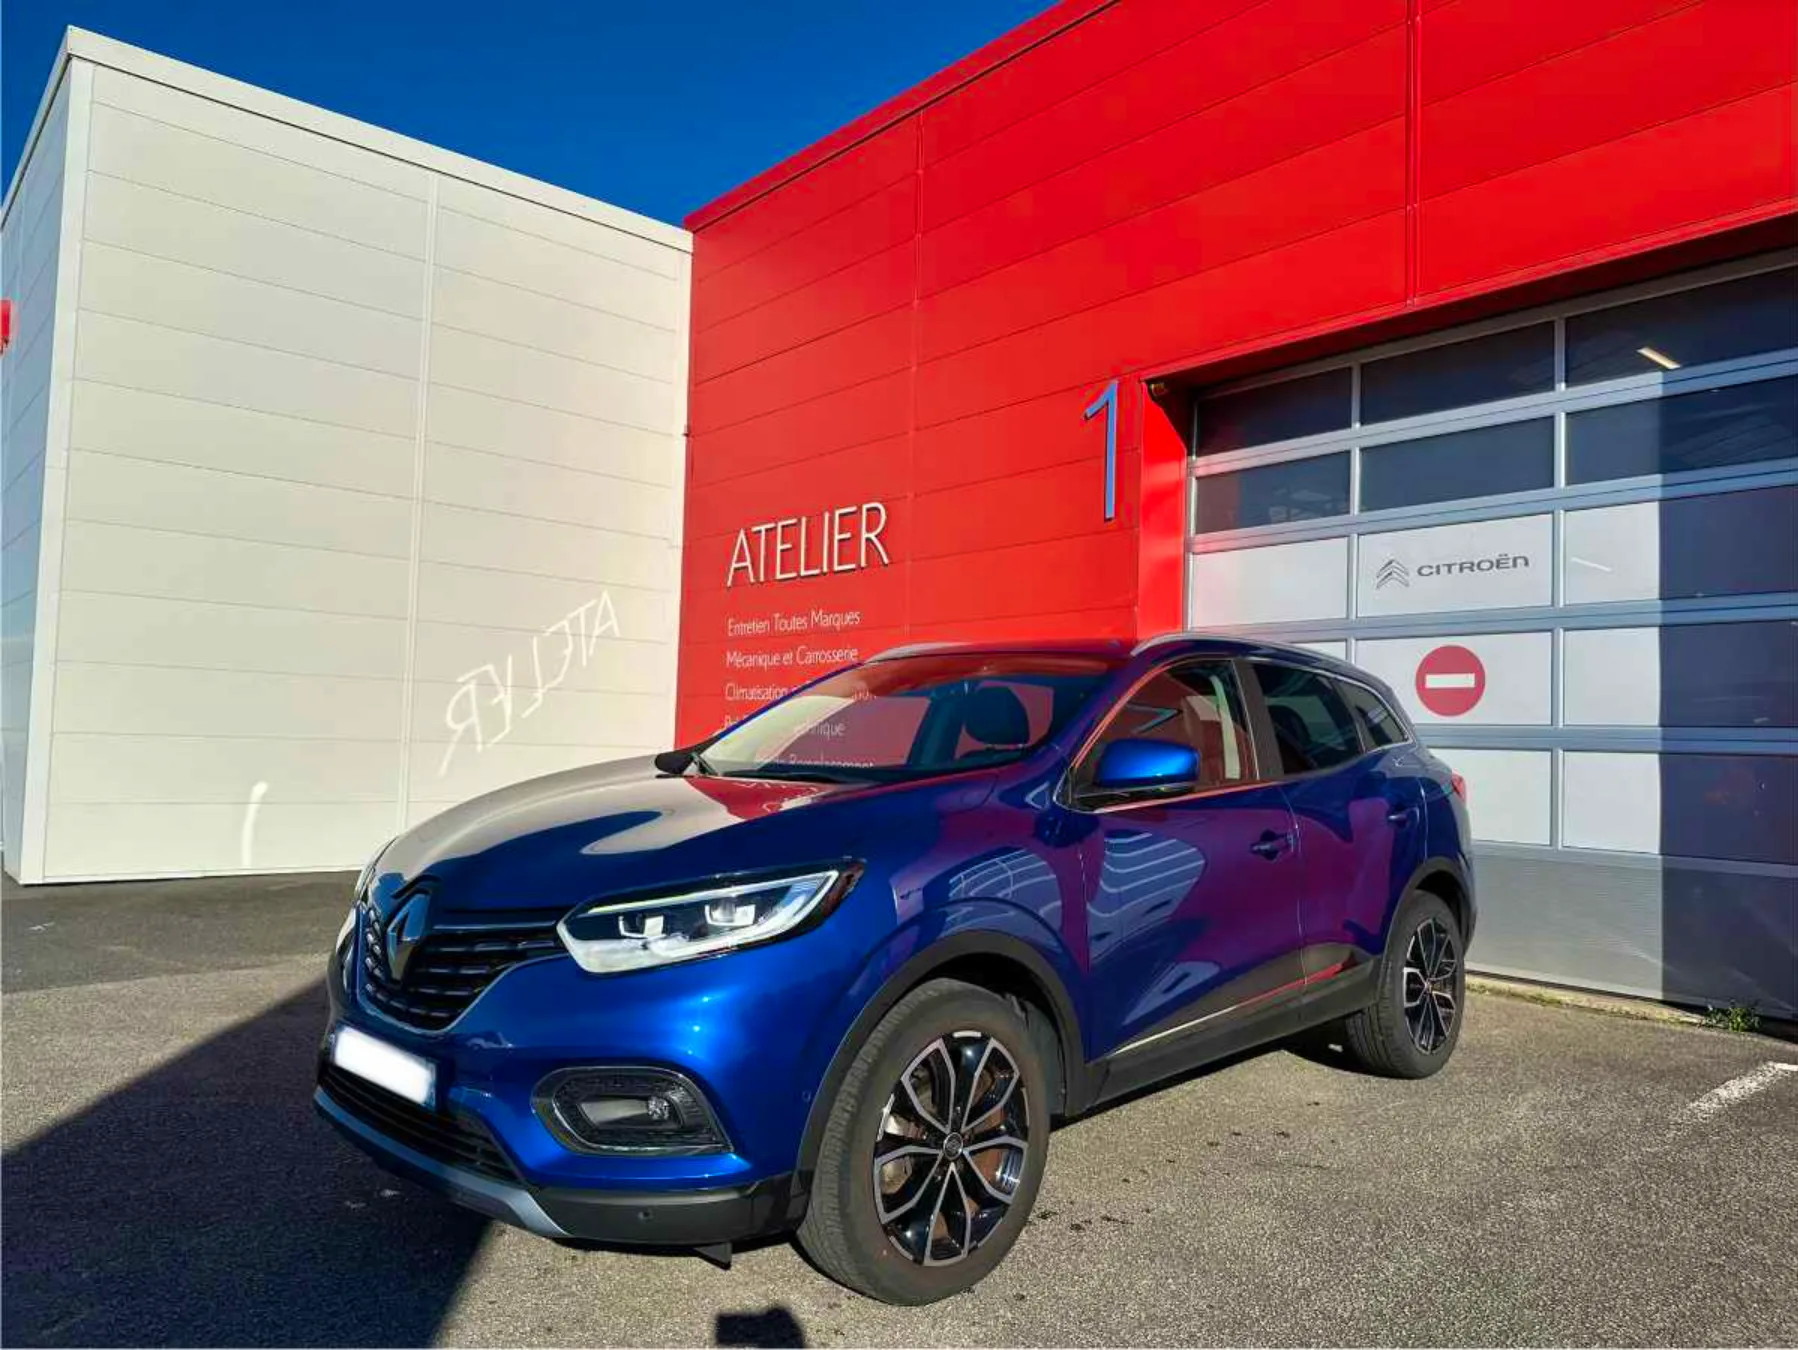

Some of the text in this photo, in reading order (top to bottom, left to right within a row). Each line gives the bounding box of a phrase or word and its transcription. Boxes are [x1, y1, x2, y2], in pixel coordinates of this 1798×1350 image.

[1083, 379, 1118, 521] 1
[726, 501, 889, 588] ATELIER
[727, 608, 861, 637] Entretien Toutes Marques
[726, 645, 859, 672] Mécanique et Carrosserie
